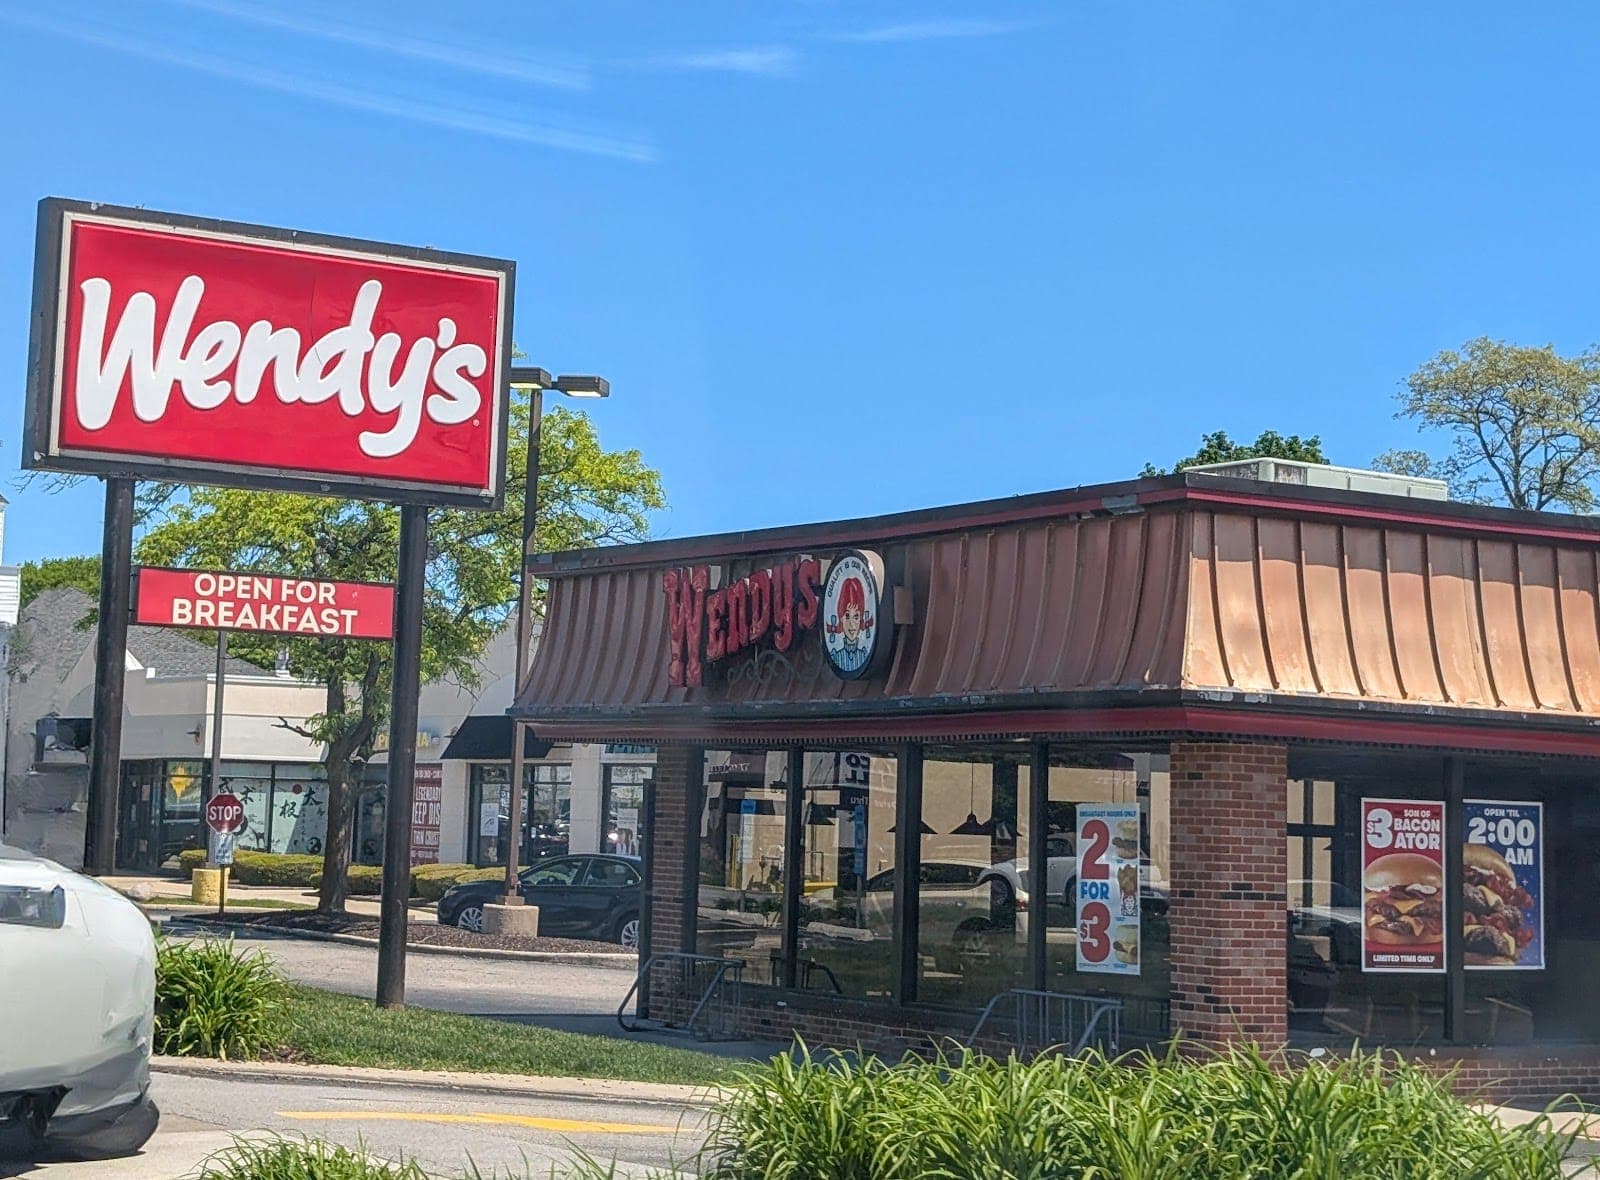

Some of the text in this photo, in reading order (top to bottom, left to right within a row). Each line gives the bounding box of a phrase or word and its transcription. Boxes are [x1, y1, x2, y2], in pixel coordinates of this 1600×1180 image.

[76, 274, 486, 458] Wendy's
[194, 573, 336, 605] OPEN FOR
[172, 598, 358, 635] BREAKFAST
[209, 806, 241, 820] STOP
[415, 801, 440, 825] EEP DIS
[1403, 809, 1419, 817] SON
[1484, 808, 1505, 817] OPEN
[1393, 818, 1440, 832] BACON
[1468, 817, 1535, 847] 2:00
[1080, 819, 1110, 880] 2
[1394, 832, 1440, 850] ATOR
[1504, 847, 1534, 866] AM
[1080, 881, 1110, 900] FOR
[1373, 954, 1436, 963] LIMITED TIME ONLY
